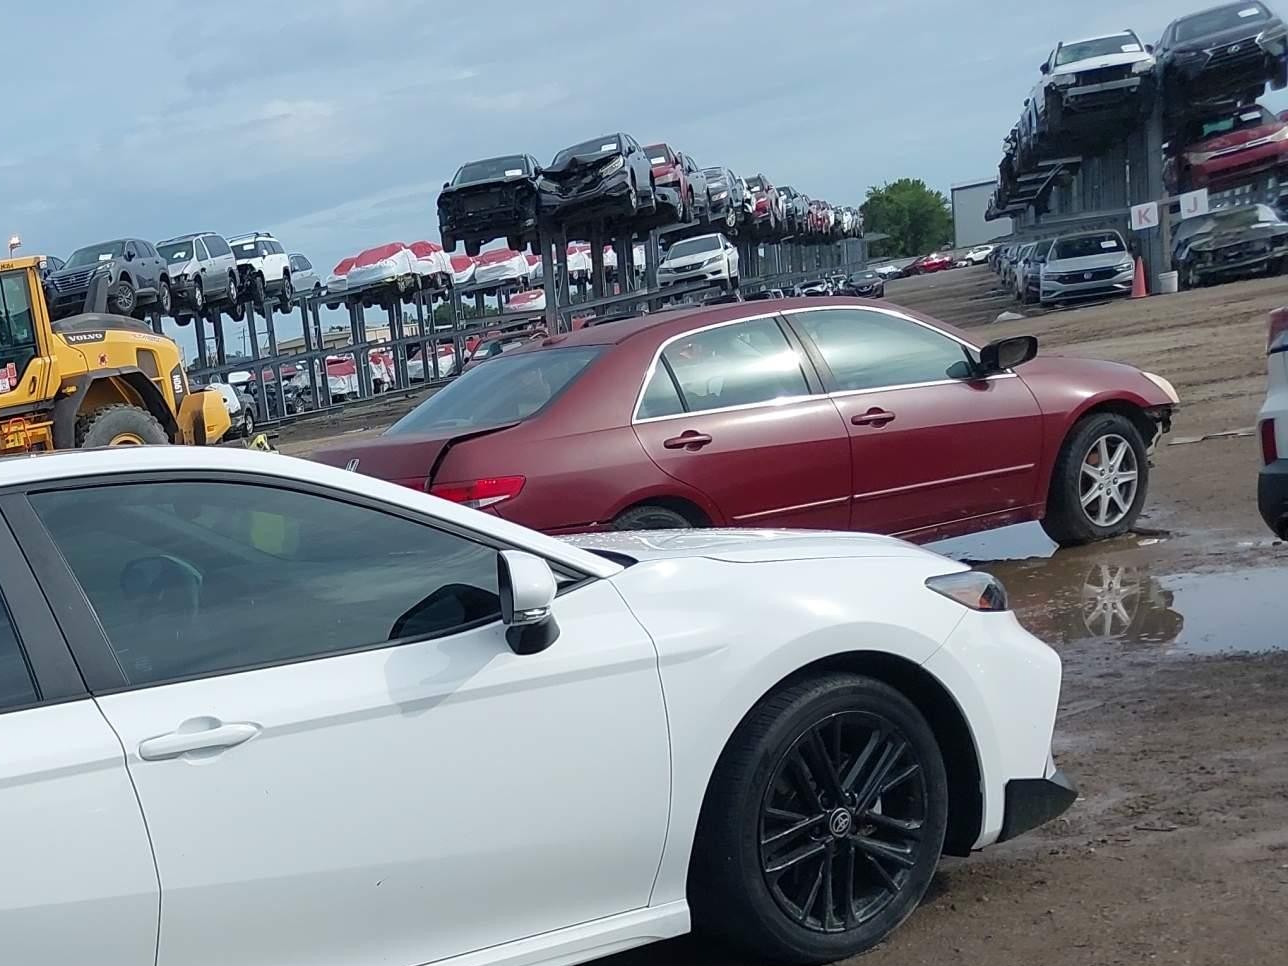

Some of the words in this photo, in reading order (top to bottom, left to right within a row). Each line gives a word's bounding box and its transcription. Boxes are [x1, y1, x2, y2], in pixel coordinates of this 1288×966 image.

[1187, 196, 1198, 214] J
[1137, 207, 1152, 225] K
[68, 333, 103, 342] VOLVO
[173, 375, 183, 393] L90H
